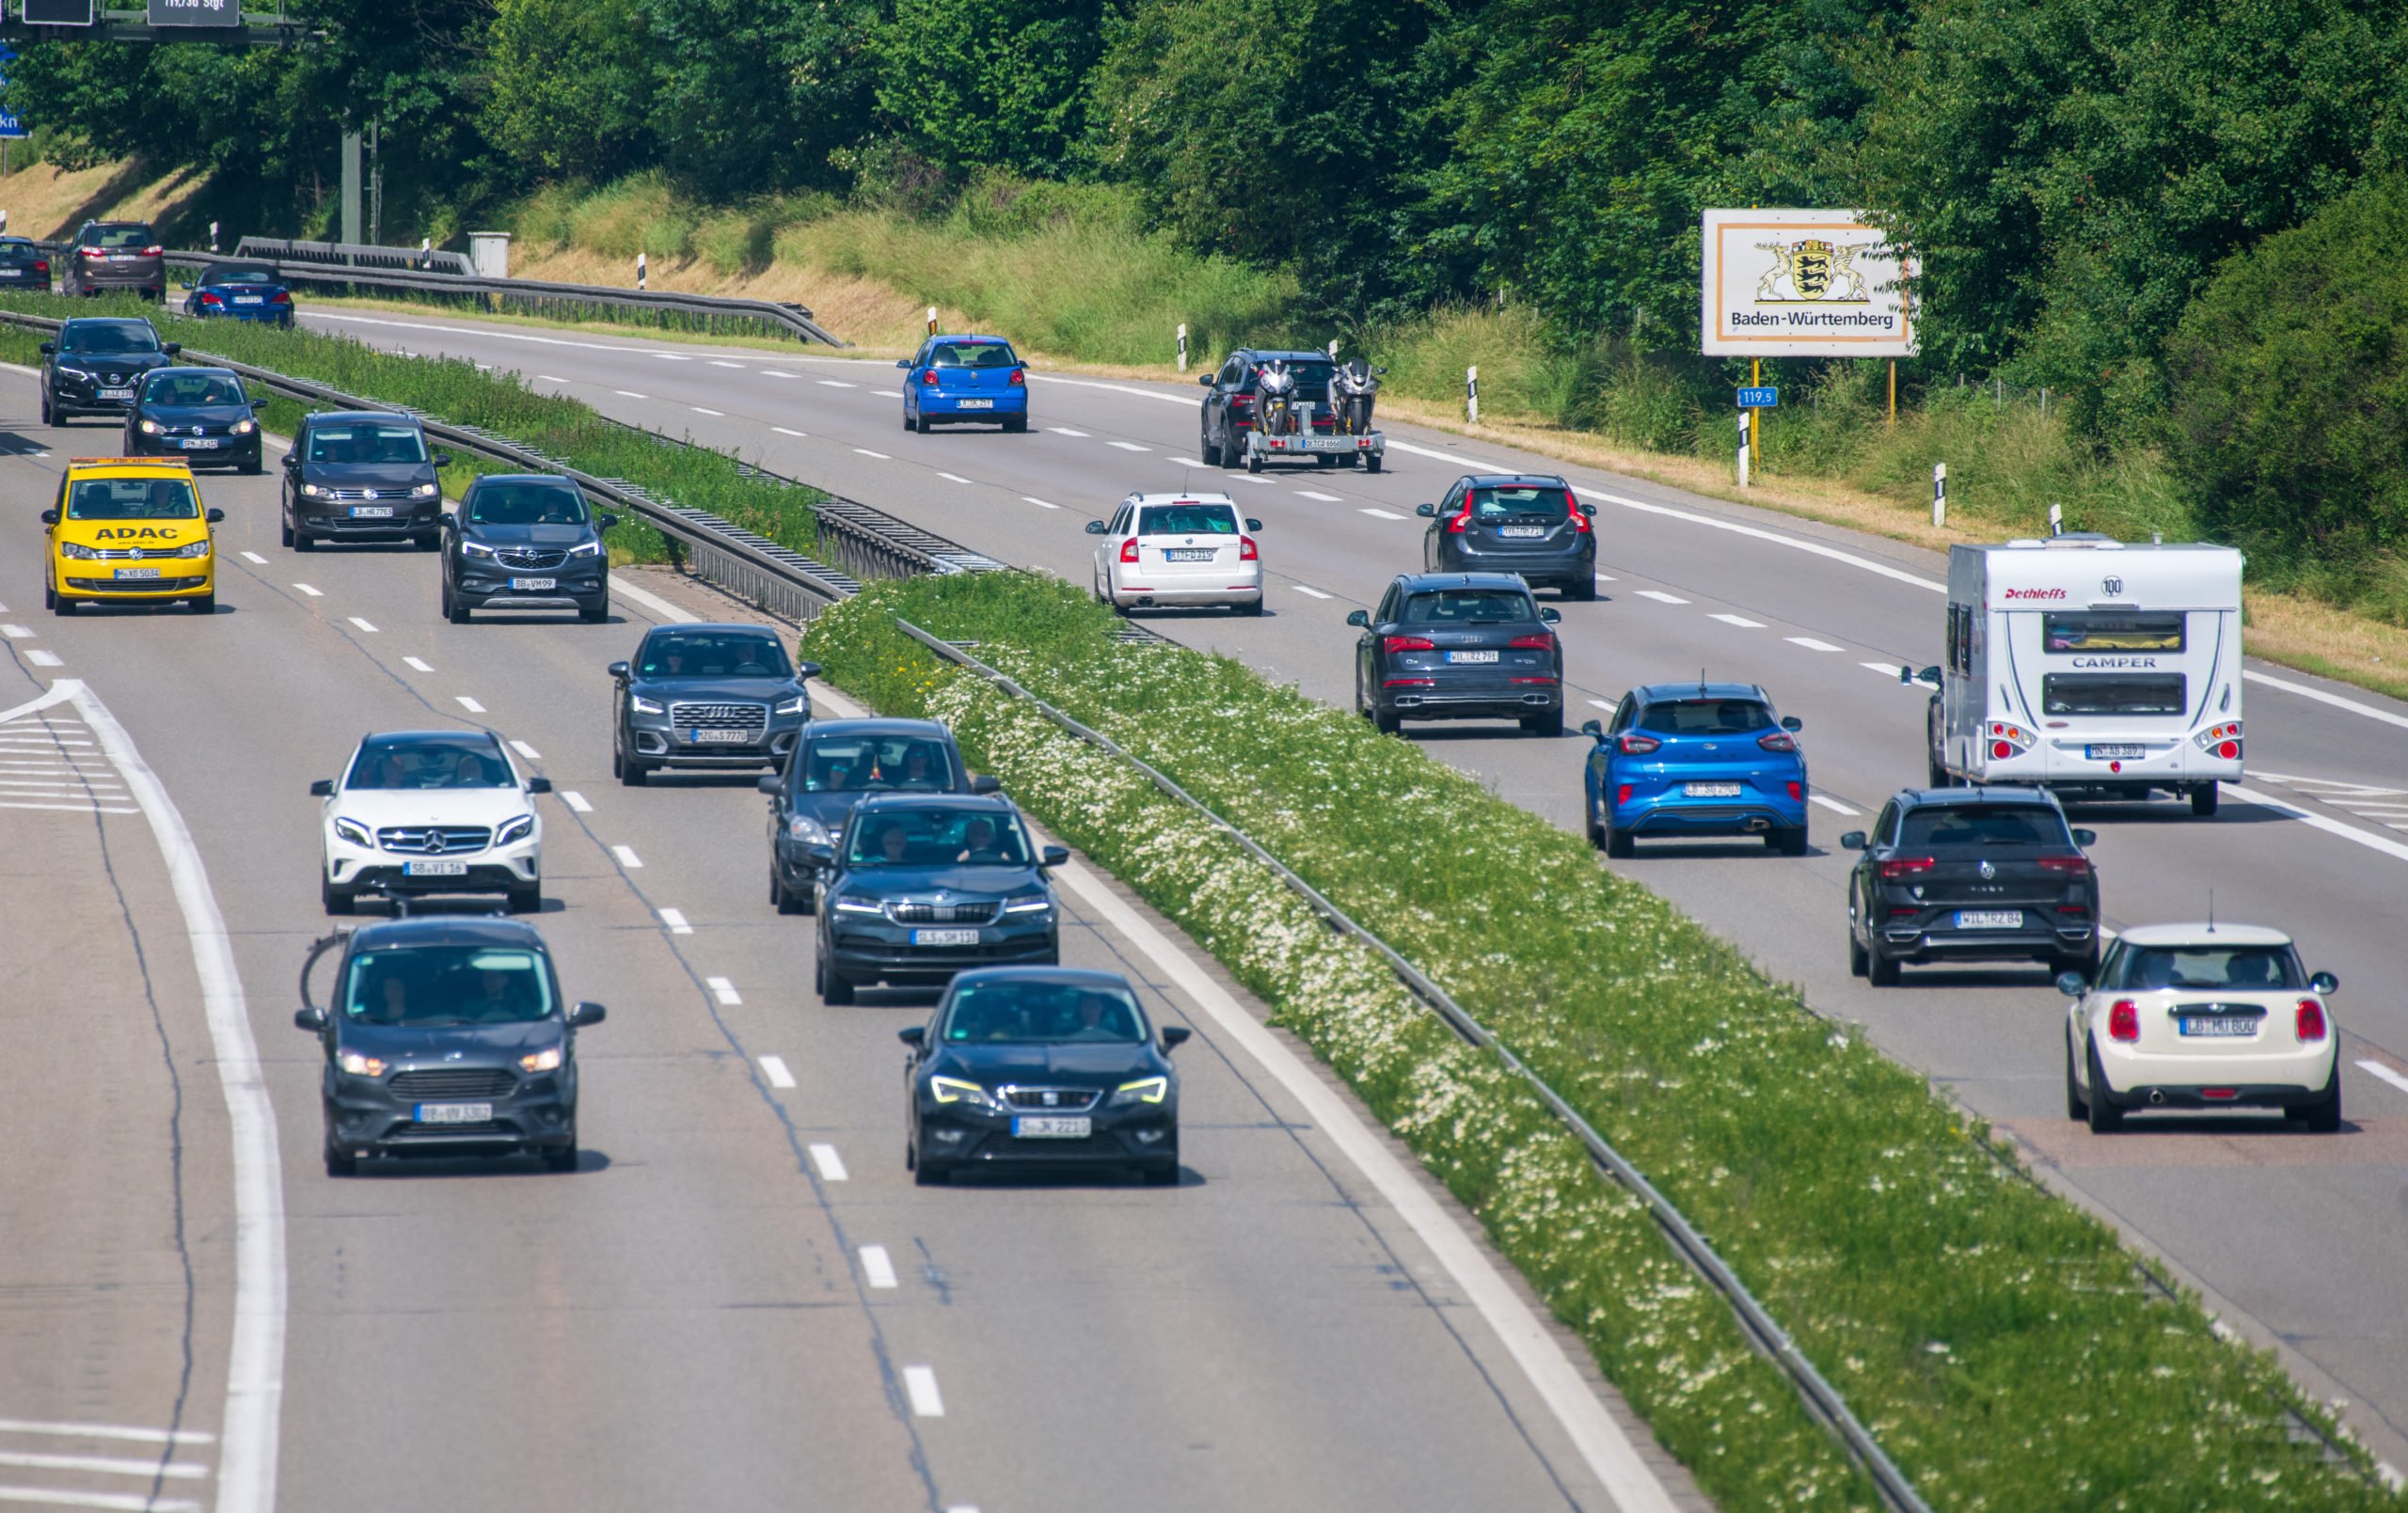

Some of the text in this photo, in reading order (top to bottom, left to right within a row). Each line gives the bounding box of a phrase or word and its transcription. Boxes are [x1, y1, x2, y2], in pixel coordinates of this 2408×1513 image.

[1732, 310, 1893, 329] Baden-Württemberg
[1744, 391, 1772, 403] 119.5
[95, 528, 179, 541] ADAC
[2103, 578, 2121, 593] 100
[2004, 588, 2067, 600] Dethleffs
[2072, 656, 2157, 668] CAMPER
